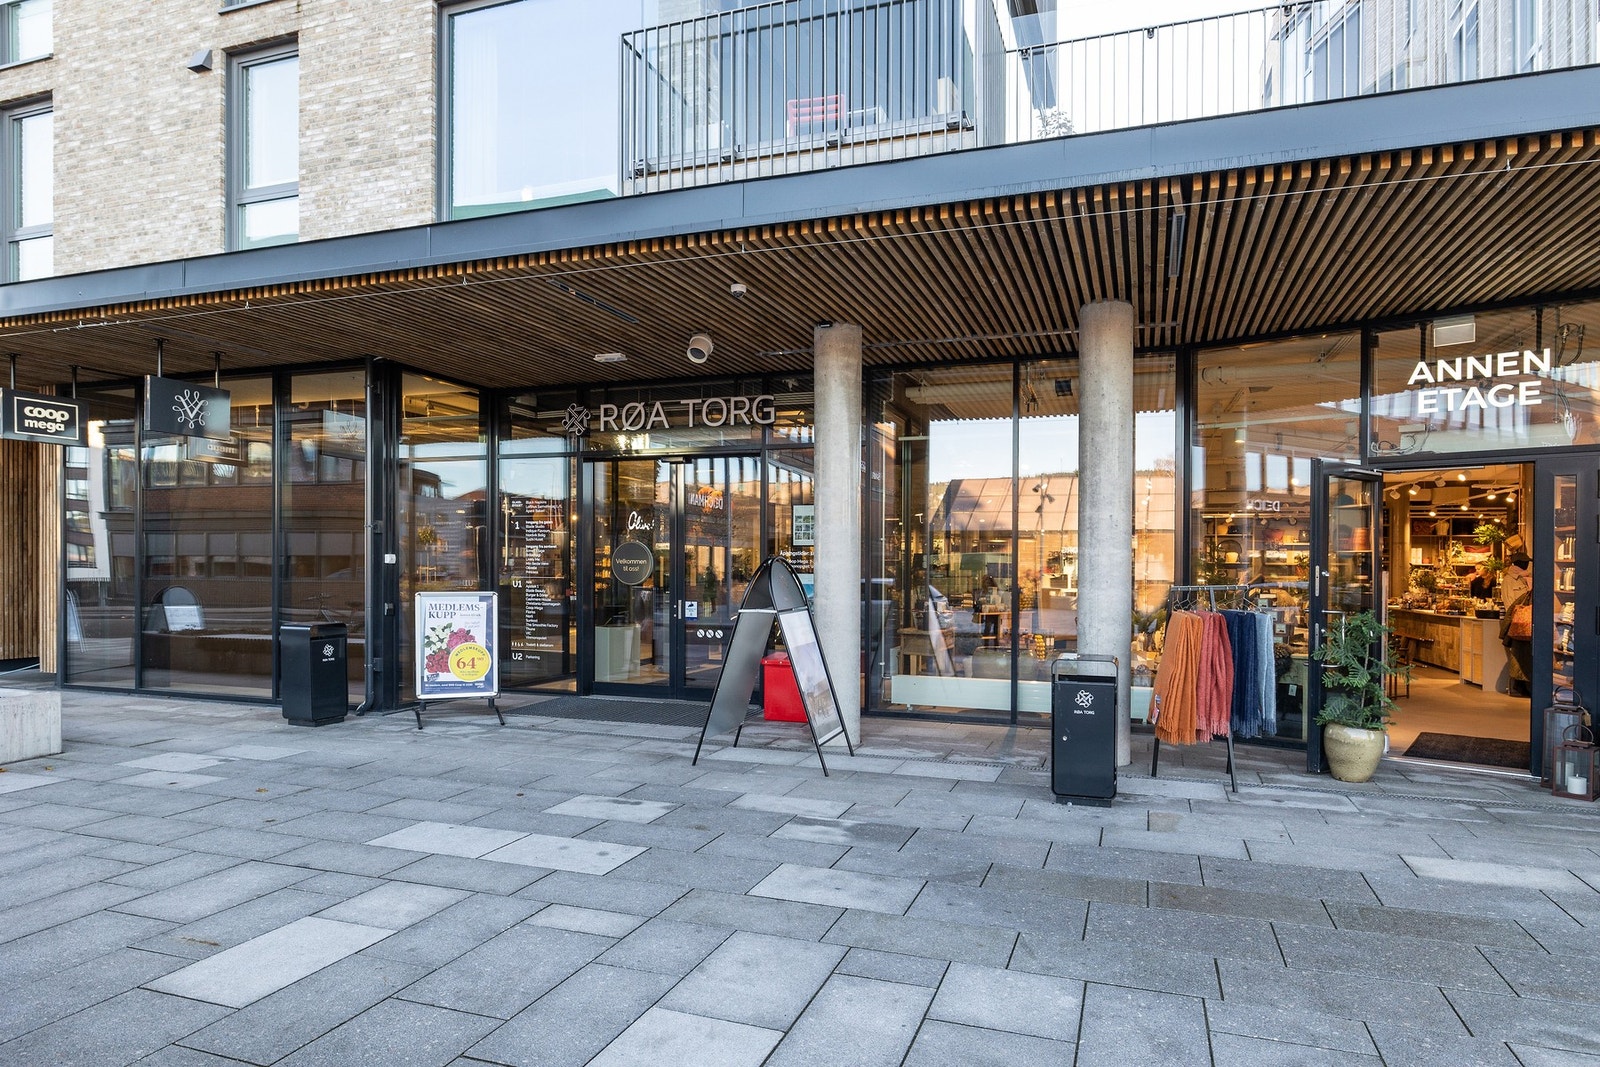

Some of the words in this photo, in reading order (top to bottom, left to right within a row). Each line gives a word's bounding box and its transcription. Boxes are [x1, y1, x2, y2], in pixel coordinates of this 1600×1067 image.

[1408, 348, 1552, 385] ANNEN
[1418, 380, 1542, 414] ETAGE
[24, 406, 70, 422] coop
[600, 402, 670, 432] RØA
[680, 395, 776, 428] TORG
[24, 419, 64, 433] mega
[428, 603, 483, 611] MEDLEMS-
[456, 657, 477, 669] 64
